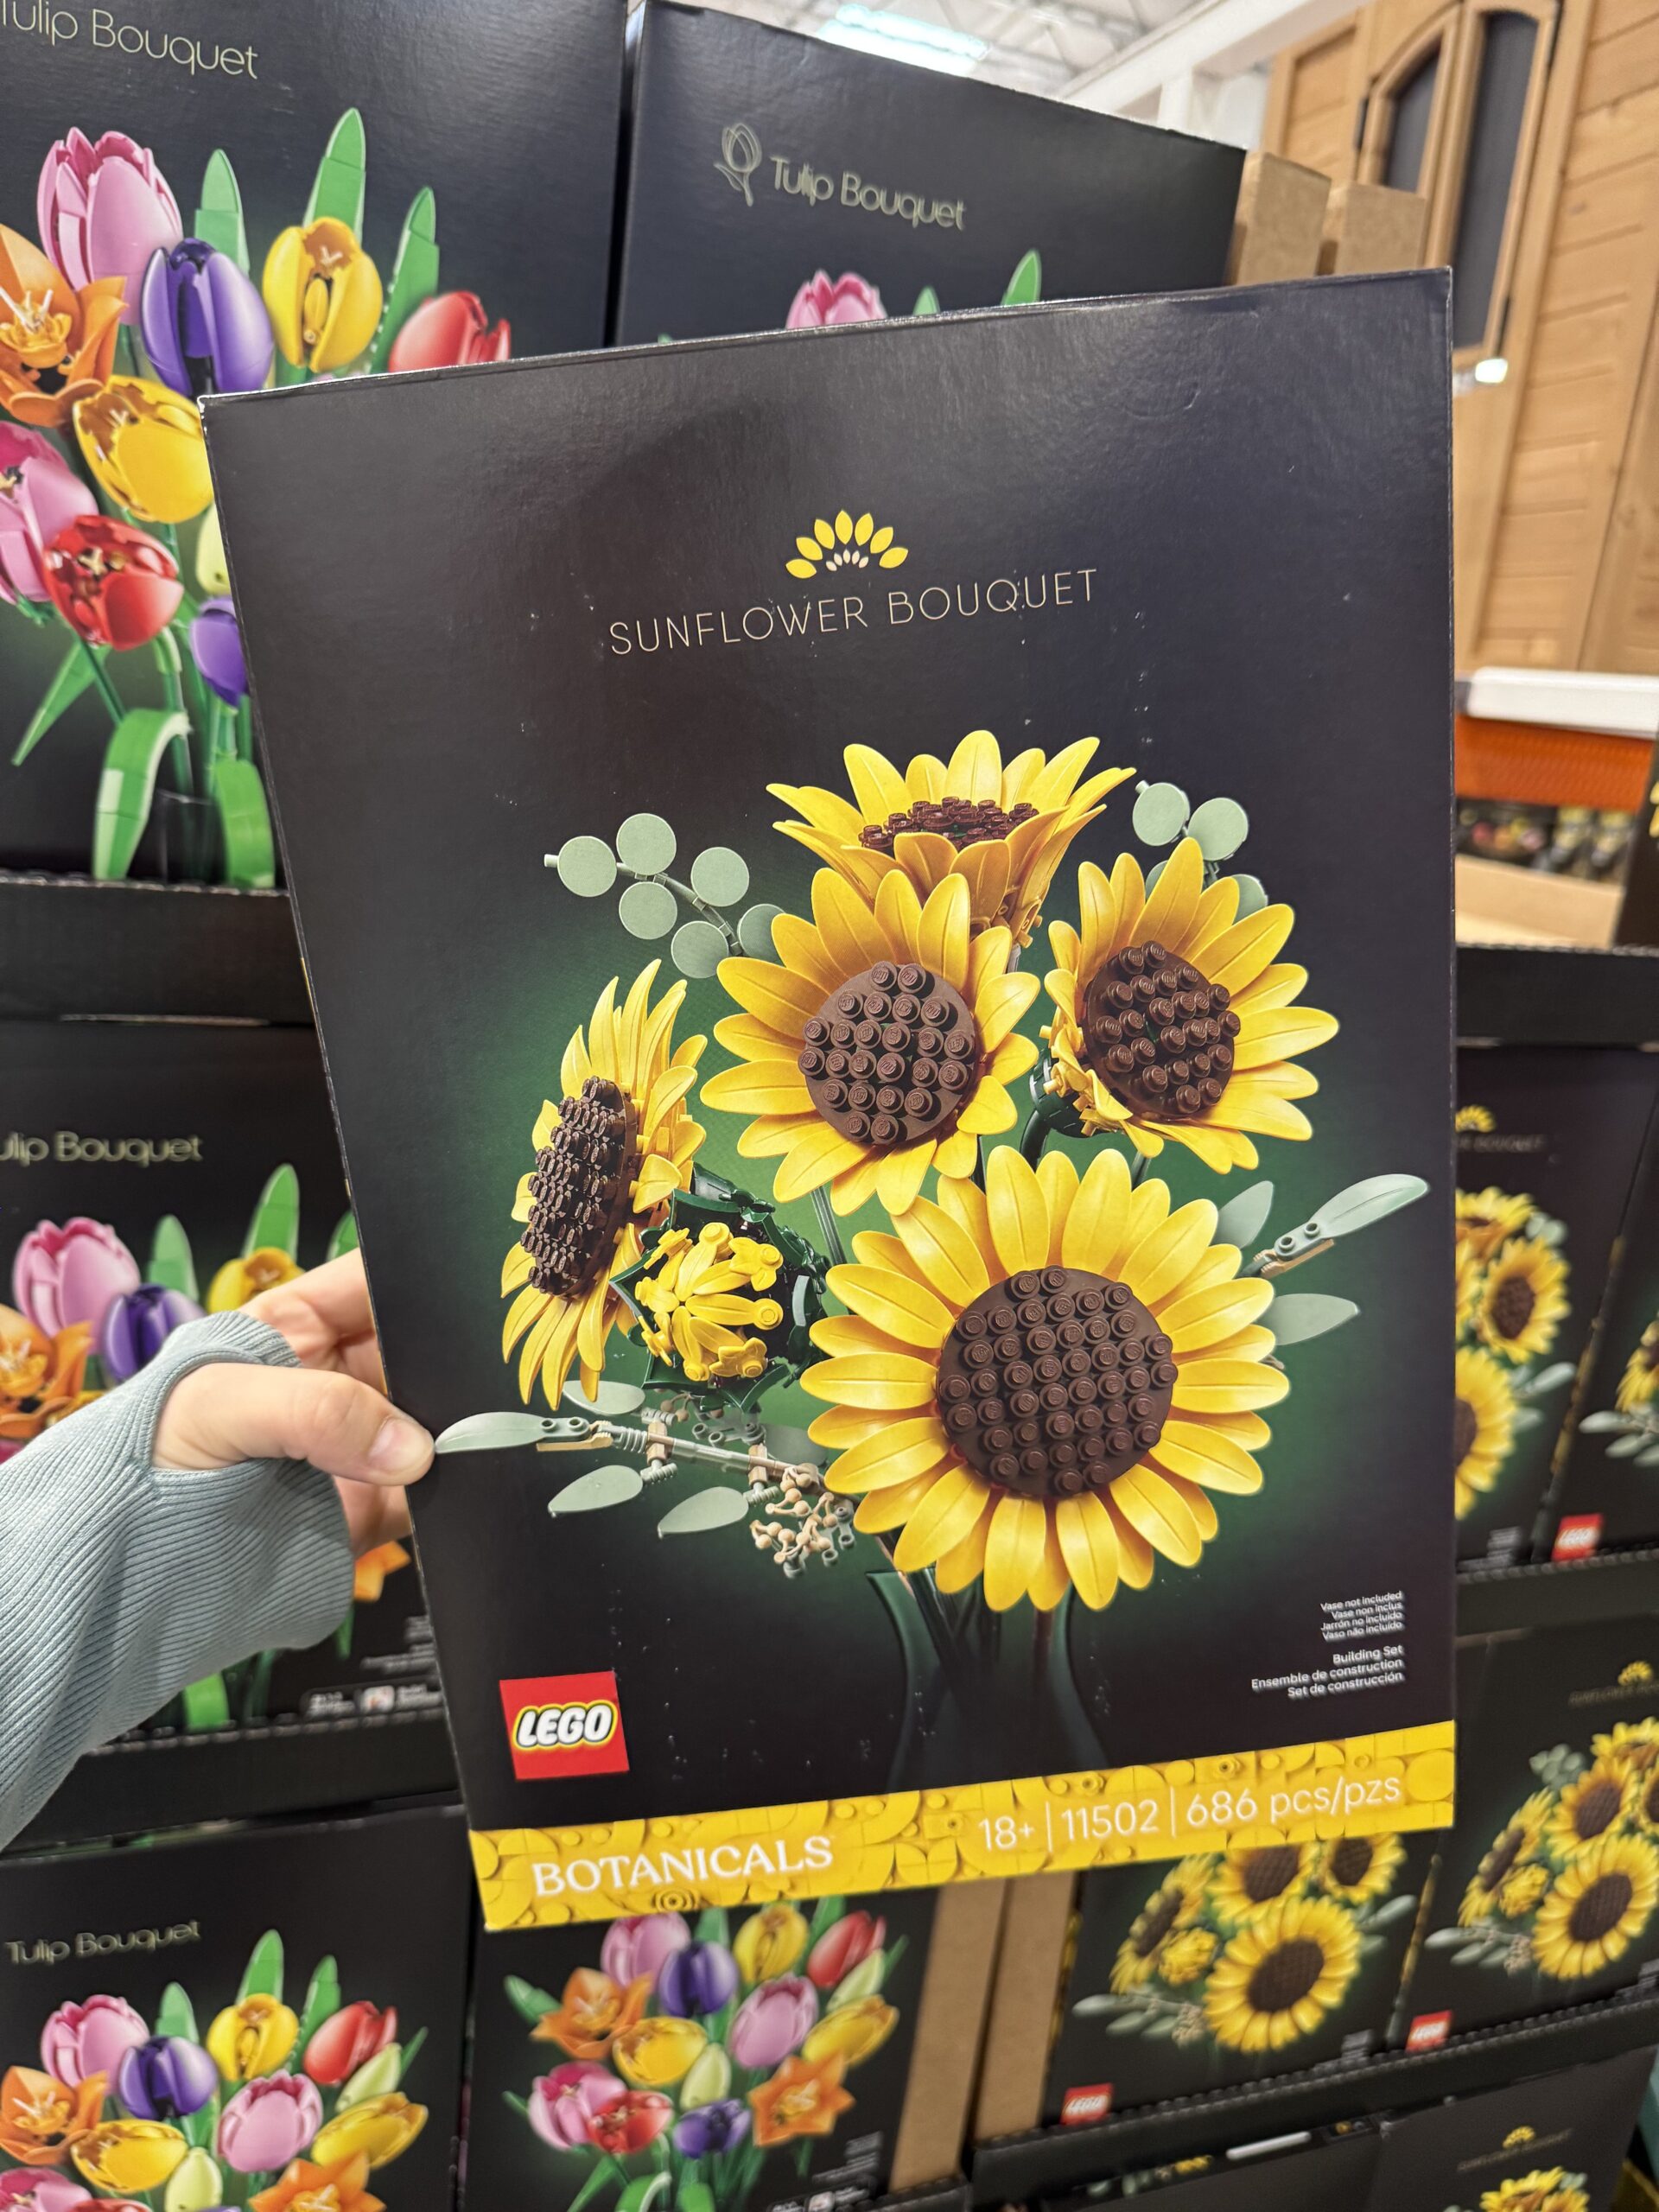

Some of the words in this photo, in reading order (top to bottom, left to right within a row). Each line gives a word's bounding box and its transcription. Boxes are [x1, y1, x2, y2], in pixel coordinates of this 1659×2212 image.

[92, 8, 258, 80] Bouquet
[769, 155, 835, 207] Tulip
[840, 170, 966, 231] Bouquet
[609, 596, 868, 655] SUNFLOWER
[888, 569, 1097, 625] BOUQUET
[54, 1130, 202, 1168] Bouquet
[1320, 1601, 1344, 1613] Vase
[1344, 1598, 1361, 1609] not
[1362, 1591, 1403, 1605] included
[1332, 1610, 1354, 1621] Vase
[1355, 1607, 1373, 1617] non
[1375, 1602, 1403, 1613] inclus
[1320, 1619, 1351, 1631] Jarrón
[1351, 1618, 1364, 1626] no
[1322, 1630, 1345, 1642] Vaso
[1346, 1627, 1365, 1638] não
[1332, 1648, 1382, 1665] Building
[1382, 1644, 1404, 1657] Set
[1251, 1672, 1311, 1691] Ensemble
[1312, 1669, 1328, 1681] de
[1329, 1658, 1406, 1680] construction
[1287, 1685, 1309, 1699] Set
[1309, 1683, 1326, 1695] de
[1327, 1671, 1406, 1693] construcción
[515, 1704, 613, 1747] LEGO
[977, 1815, 1035, 1851] 18+
[1060, 1799, 1160, 1841] 11502
[1185, 1786, 1258, 1829] 686
[1268, 1776, 1401, 1824] pcs/pzs
[532, 1835, 834, 1897] BOTANICALS
[5, 1939, 70, 1966] Tulip
